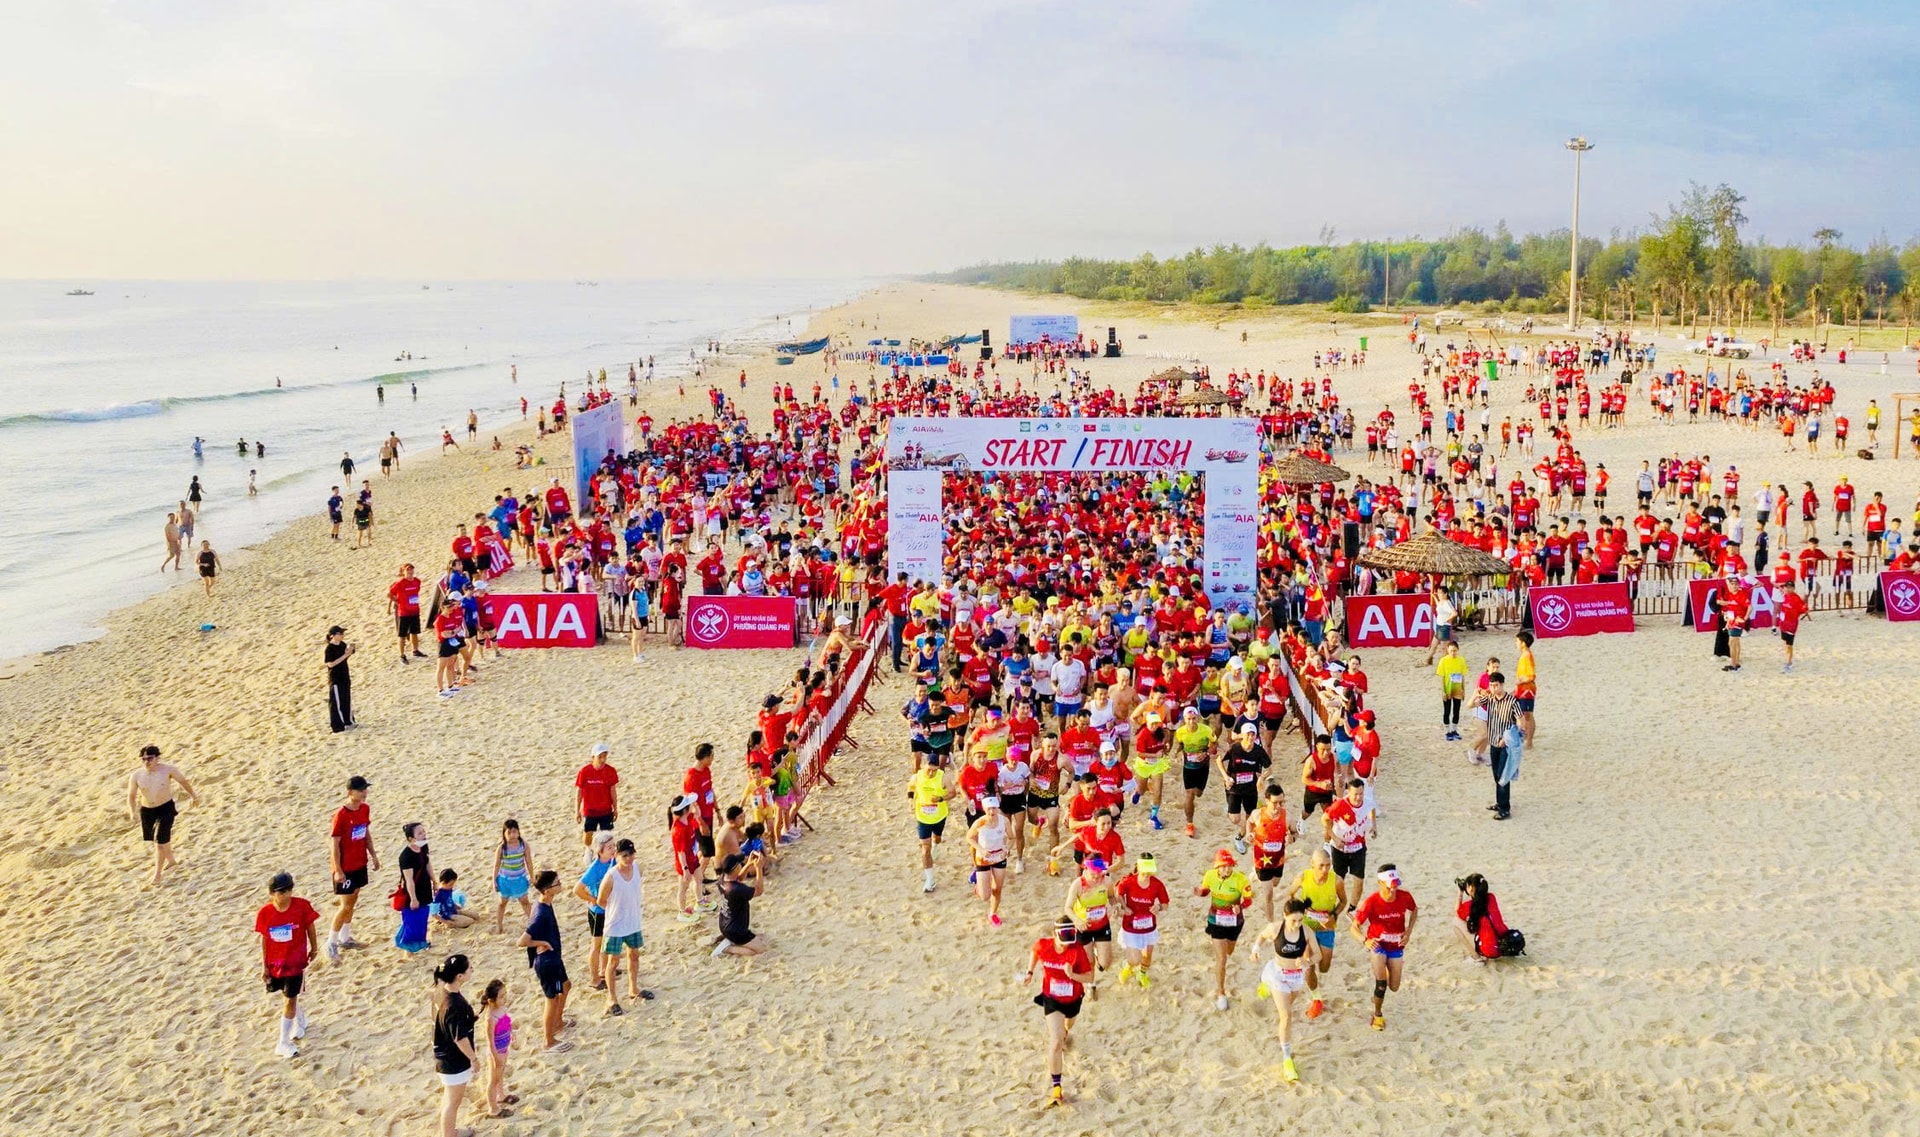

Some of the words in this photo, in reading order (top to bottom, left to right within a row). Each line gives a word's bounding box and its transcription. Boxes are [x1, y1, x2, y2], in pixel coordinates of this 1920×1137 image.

[981, 438, 1067, 467] START
[919, 513, 939, 522] AIA
[1235, 514, 1255, 523] AIA
[490, 540, 511, 573] IA
[496, 602, 587, 639] AIA
[1357, 603, 1437, 640] AIA
[342, 879, 351, 889] 19
